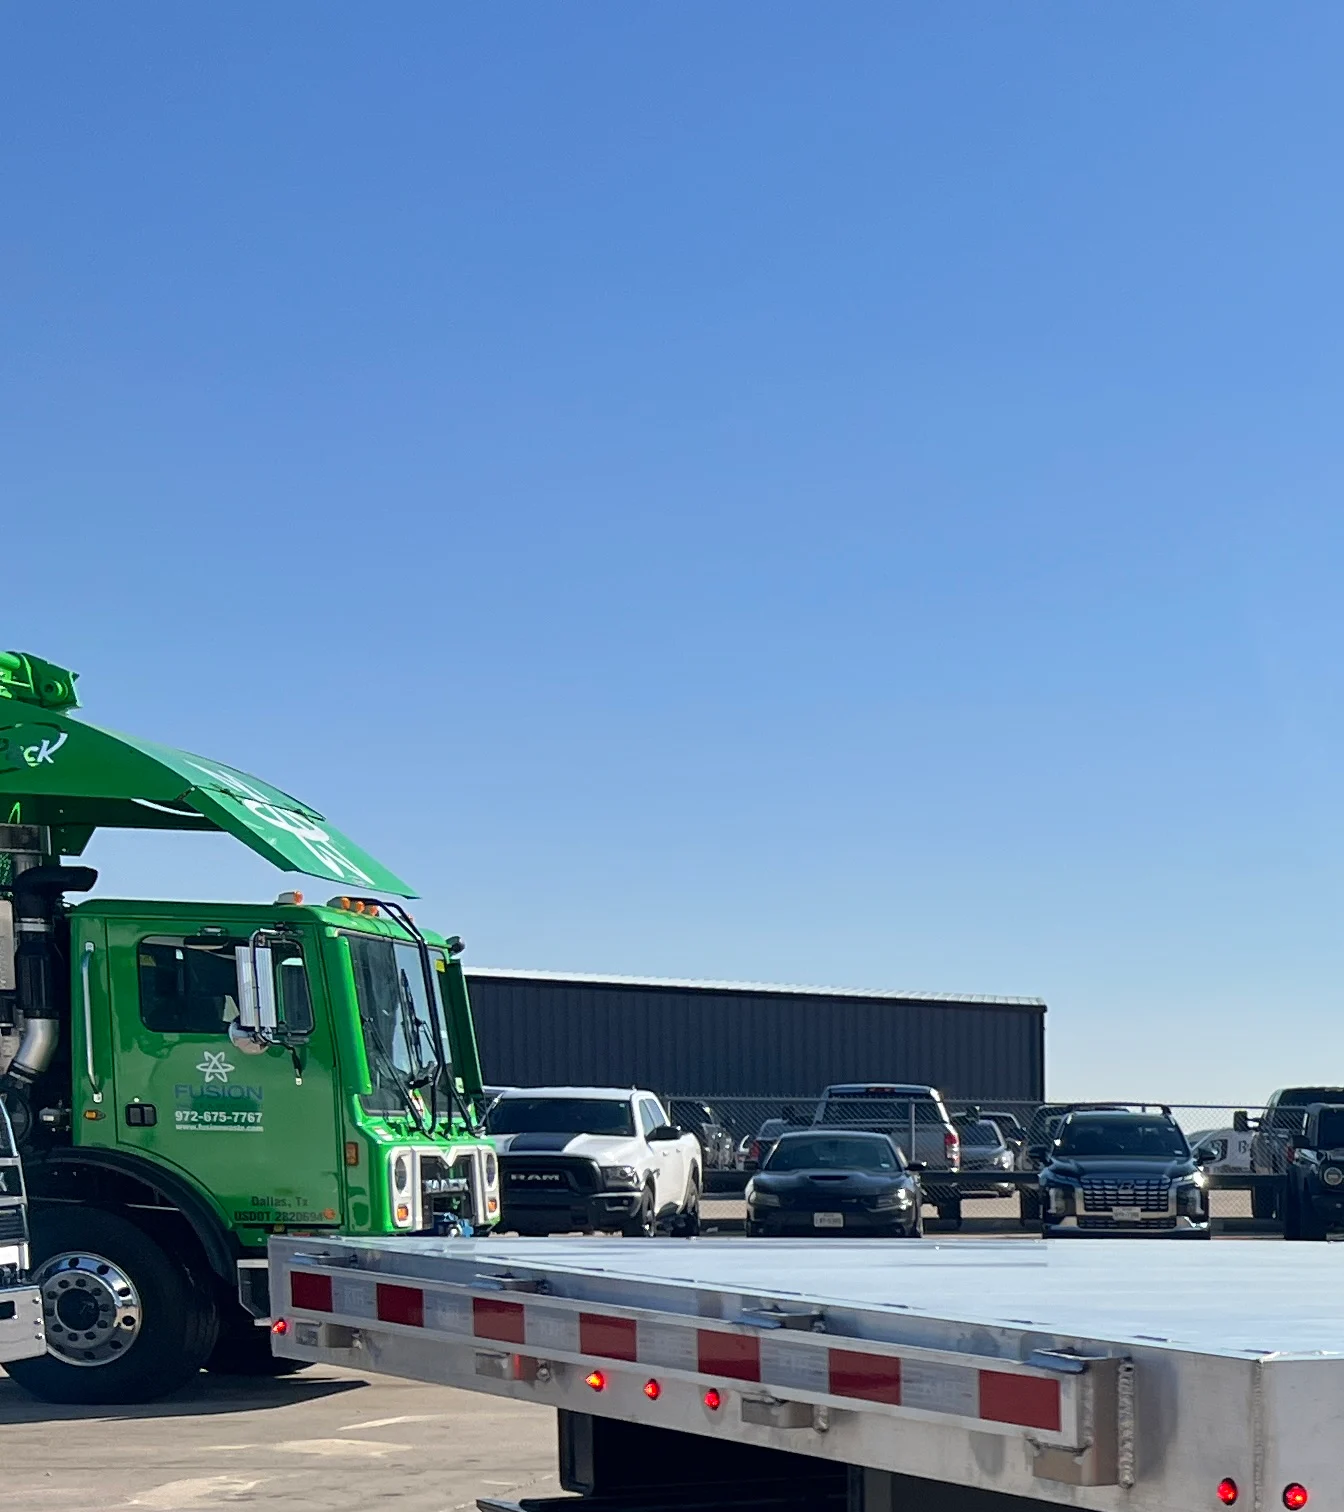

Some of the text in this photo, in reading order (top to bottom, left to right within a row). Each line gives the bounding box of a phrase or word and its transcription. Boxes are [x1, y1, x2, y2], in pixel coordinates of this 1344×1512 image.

[174, 1084, 264, 1100] FUSION
[174, 1110, 263, 1123] 972-675-7767
[251, 1196, 292, 1208] Dallas,
[234, 1211, 271, 1222] USDOT
